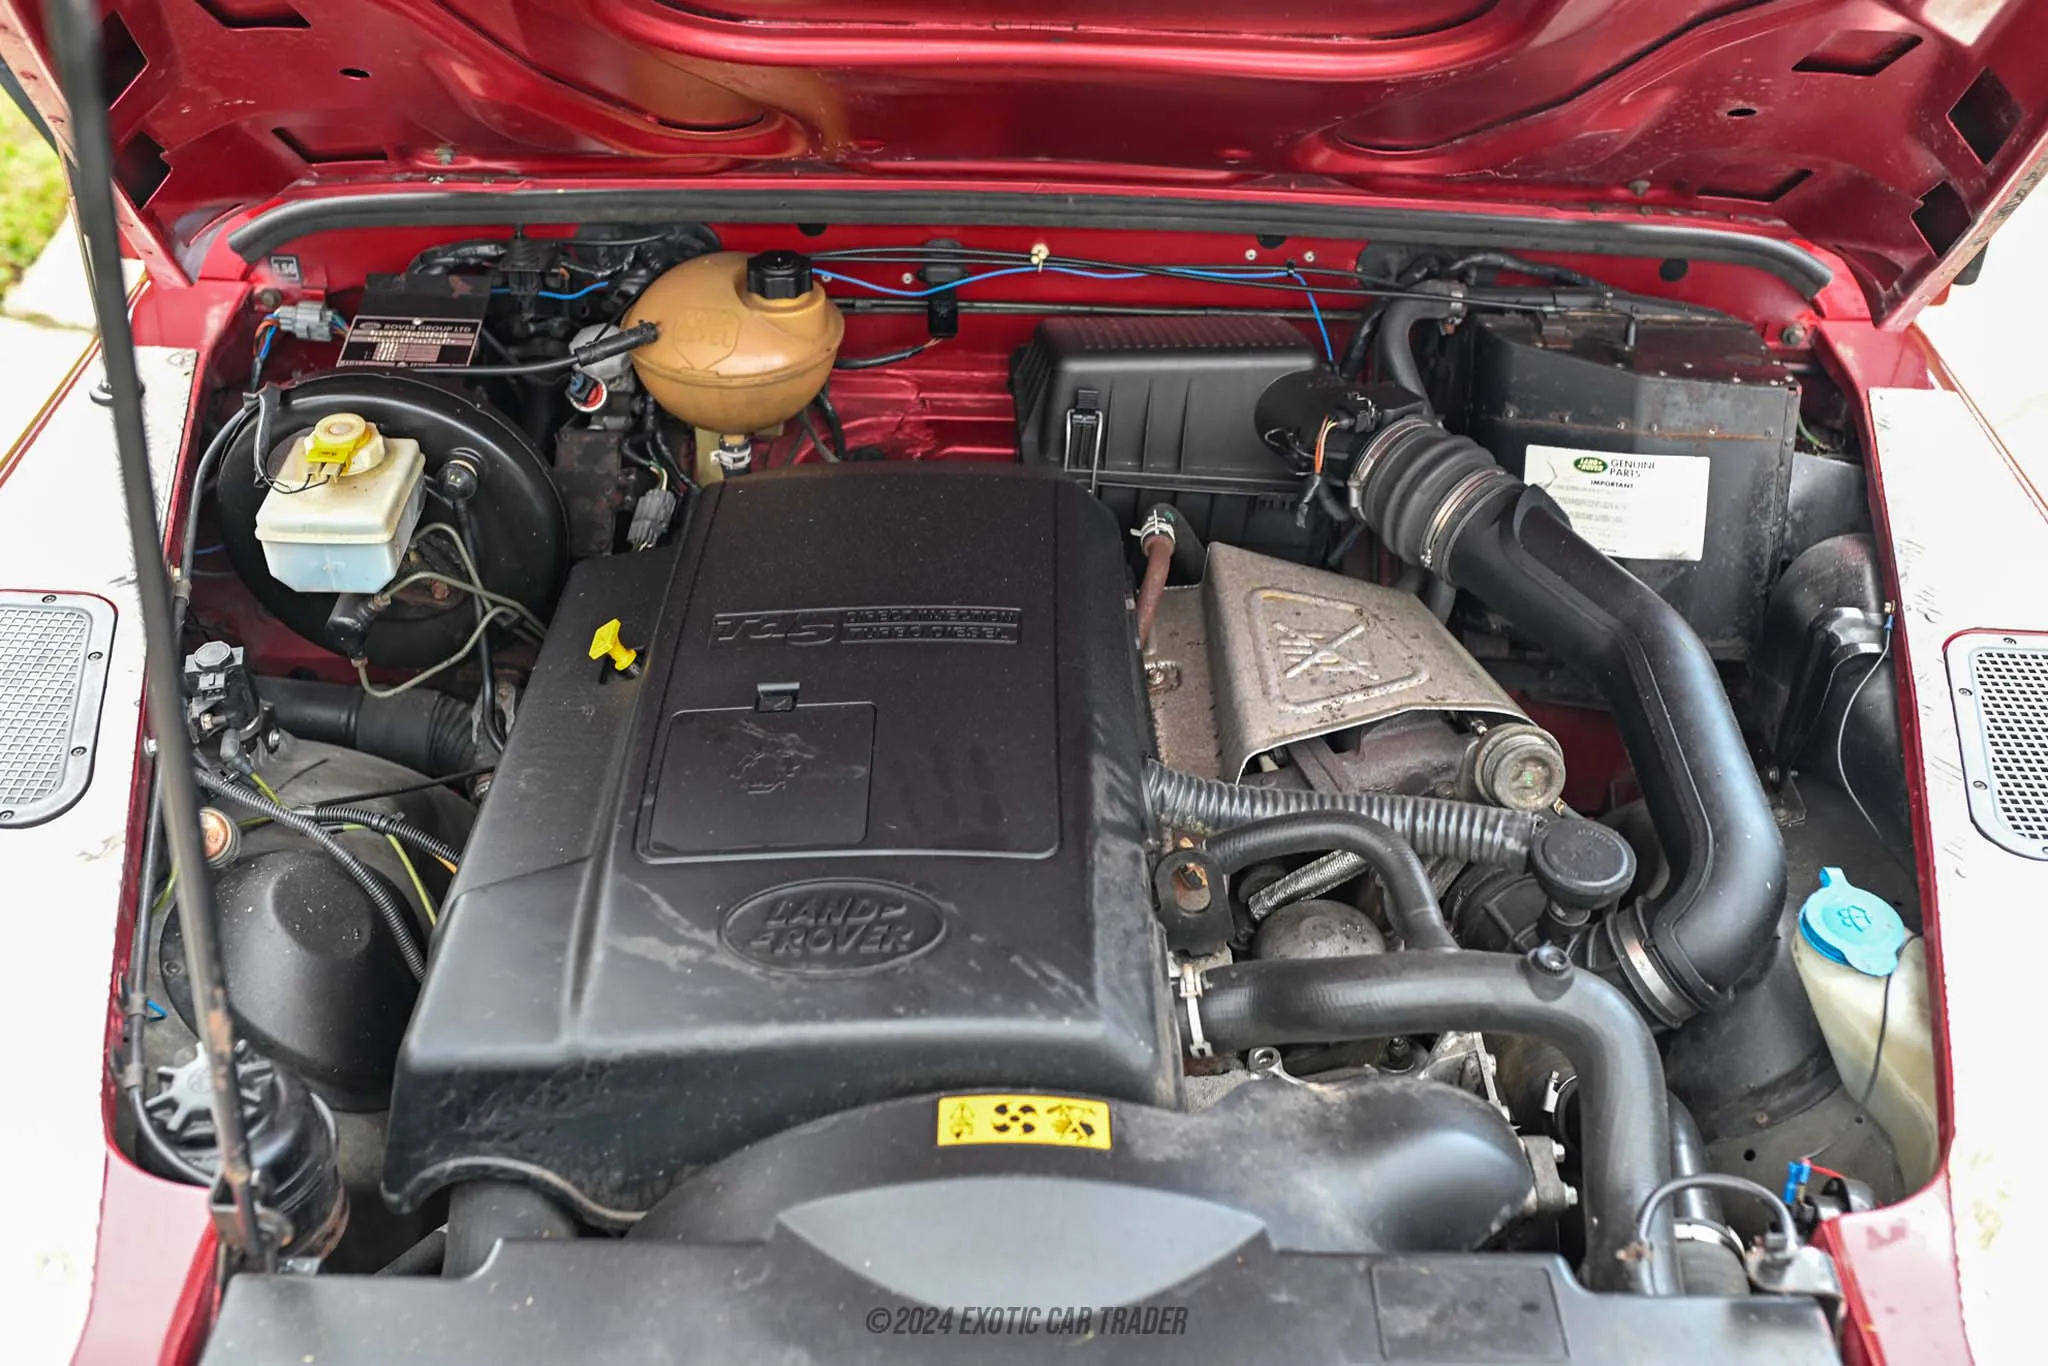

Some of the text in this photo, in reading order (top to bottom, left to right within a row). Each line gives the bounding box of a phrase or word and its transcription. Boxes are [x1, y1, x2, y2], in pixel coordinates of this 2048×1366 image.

[383, 323, 416, 331] ROVER
[1609, 467, 1641, 478] PARTS
[1590, 479, 1634, 489] IMPORTANT
[766, 898, 879, 929] LAND
[774, 923, 915, 956] ROVER
